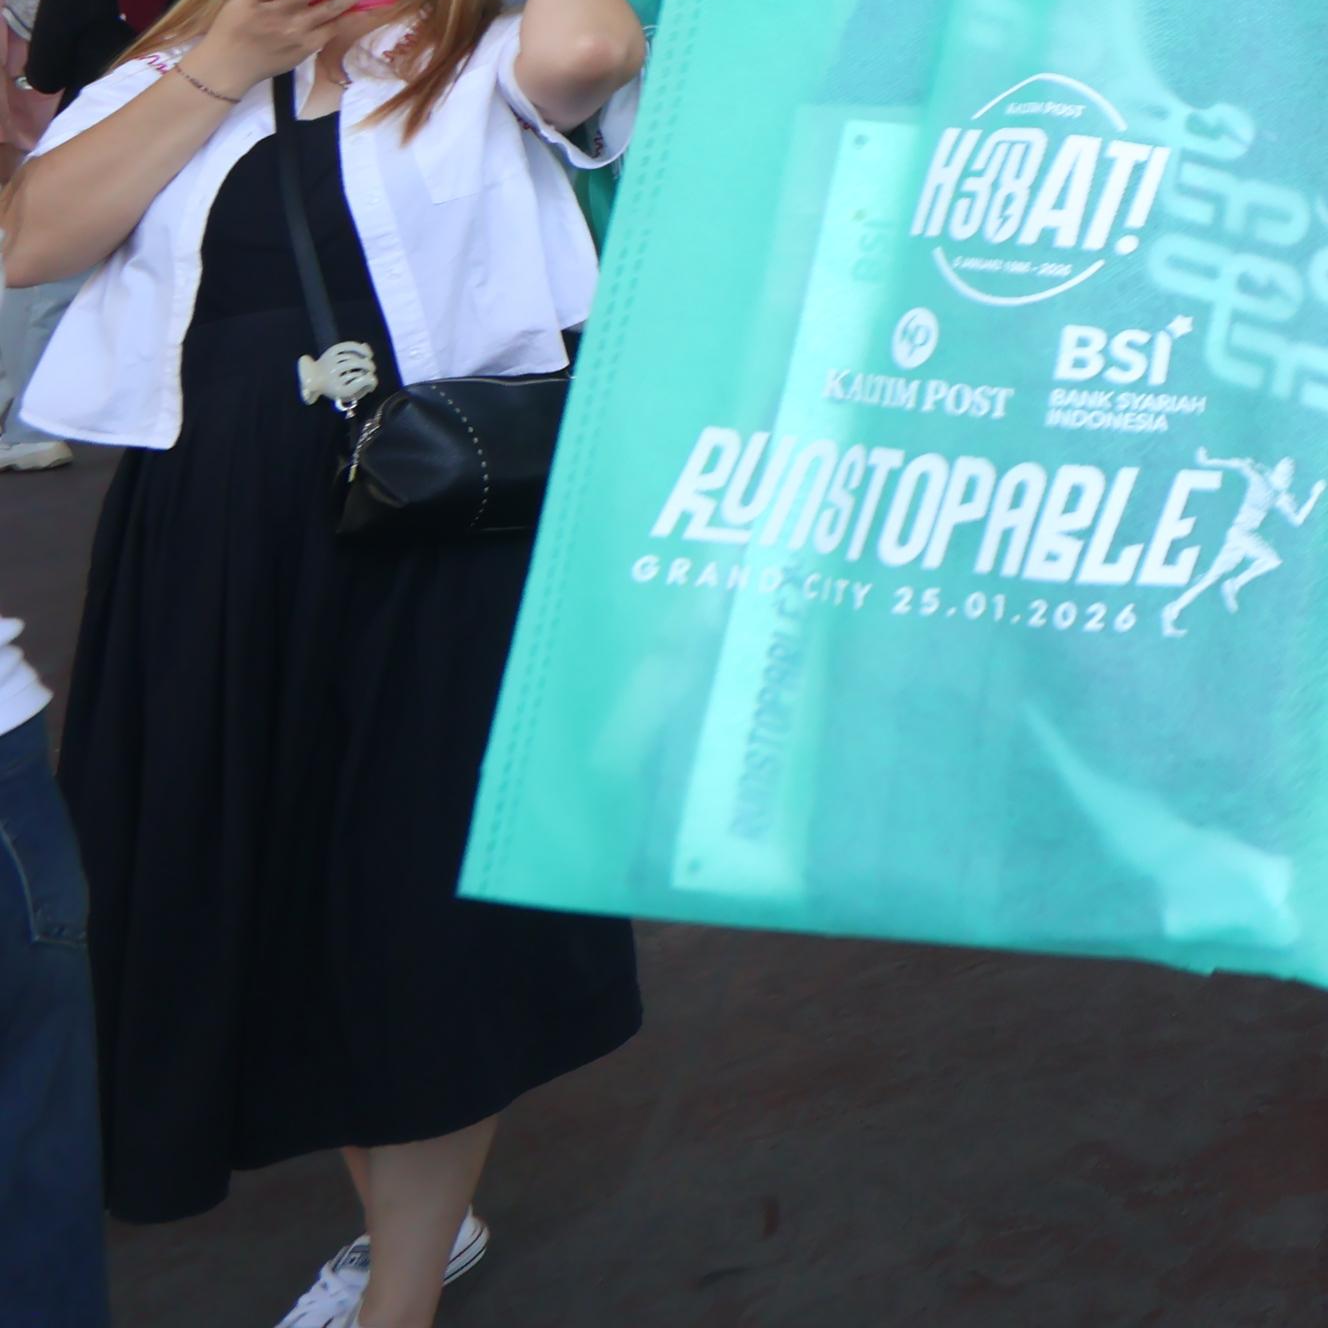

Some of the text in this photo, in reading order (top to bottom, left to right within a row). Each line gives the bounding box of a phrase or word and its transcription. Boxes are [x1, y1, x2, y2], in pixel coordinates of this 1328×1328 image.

[1052, 317, 1190, 386] BSI
[821, 369, 1015, 420] KALTIM POST
[1045, 409, 1169, 433] INDONESIA
[1048, 388, 1207, 415] BANK SYARIAH
[649, 425, 1224, 587] RUNSTOPABLE
[631, 555, 1138, 634] GRAND CITY 25.01.2026
